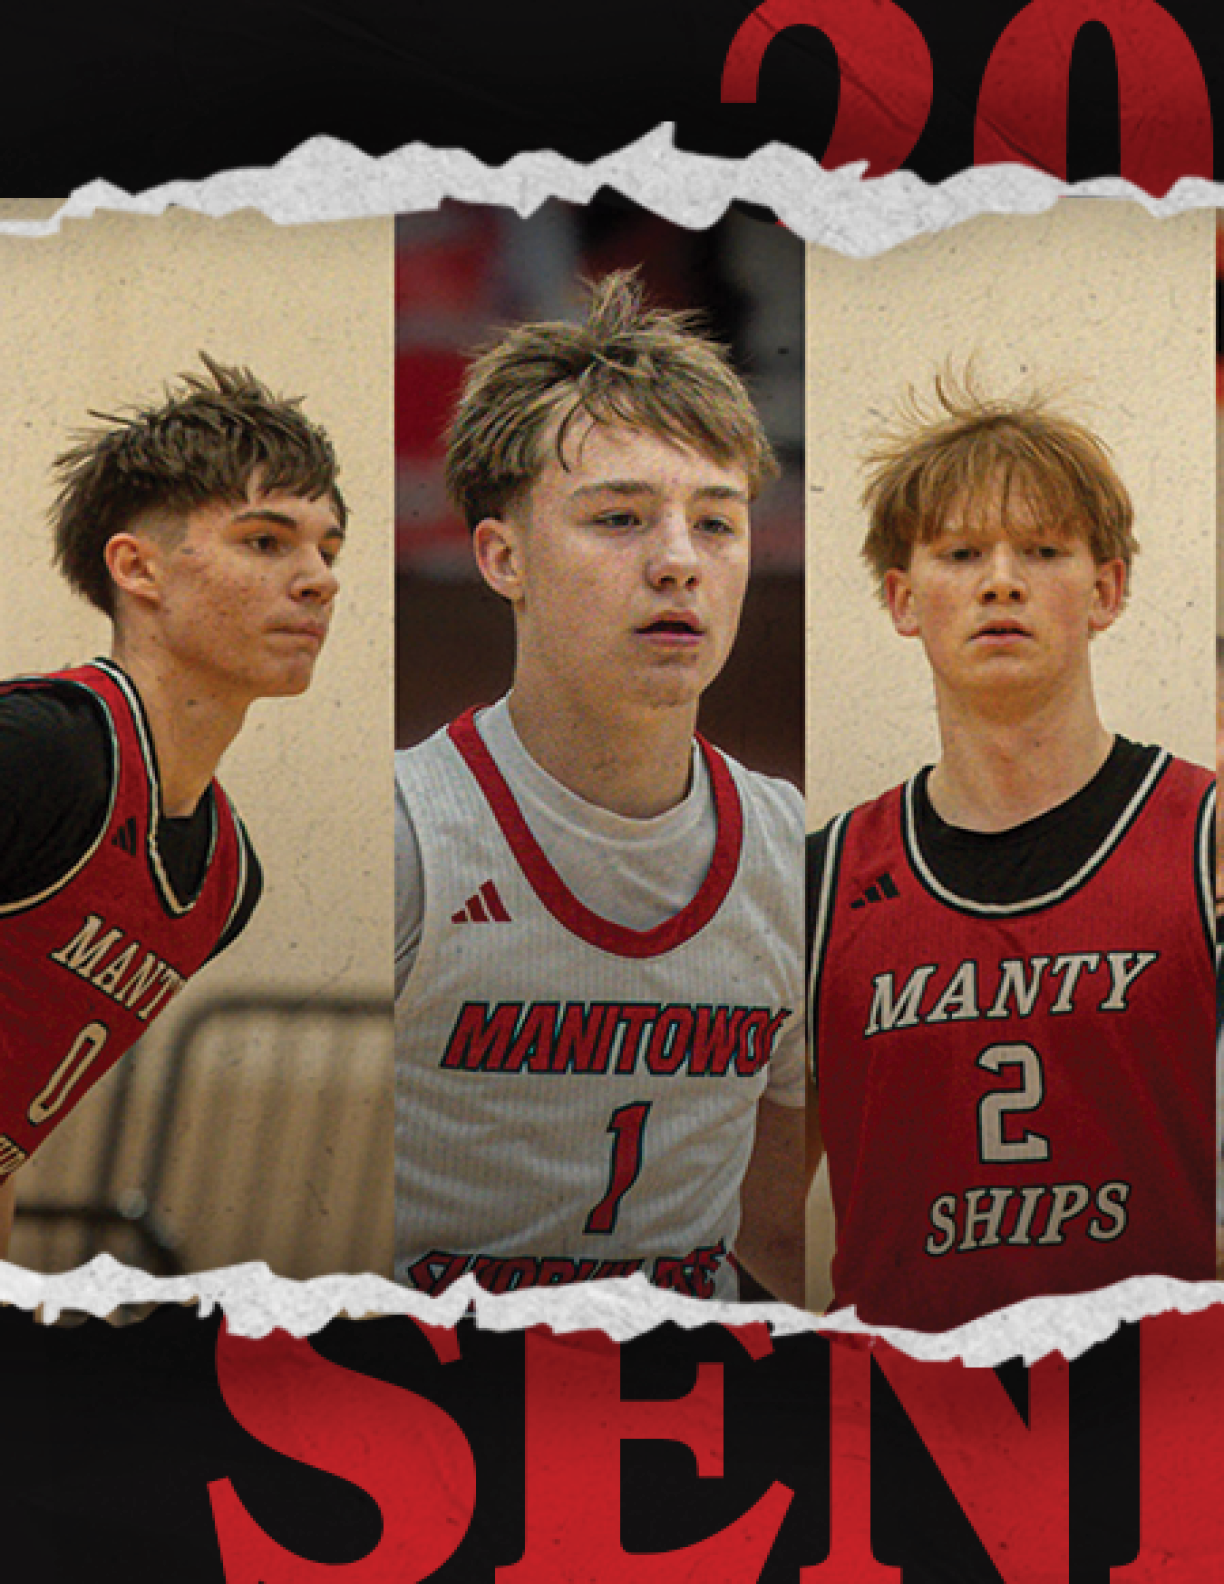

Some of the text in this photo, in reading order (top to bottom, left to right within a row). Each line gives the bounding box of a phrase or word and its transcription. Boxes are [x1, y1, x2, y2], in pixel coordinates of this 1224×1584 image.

[47, 911, 188, 1022] MANT
[863, 950, 1160, 1039] MANTY
[26, 1019, 109, 1127] 0
[974, 1039, 1052, 1165] 2
[581, 1100, 654, 1236] 1
[924, 1180, 1132, 1256] SHIPS
